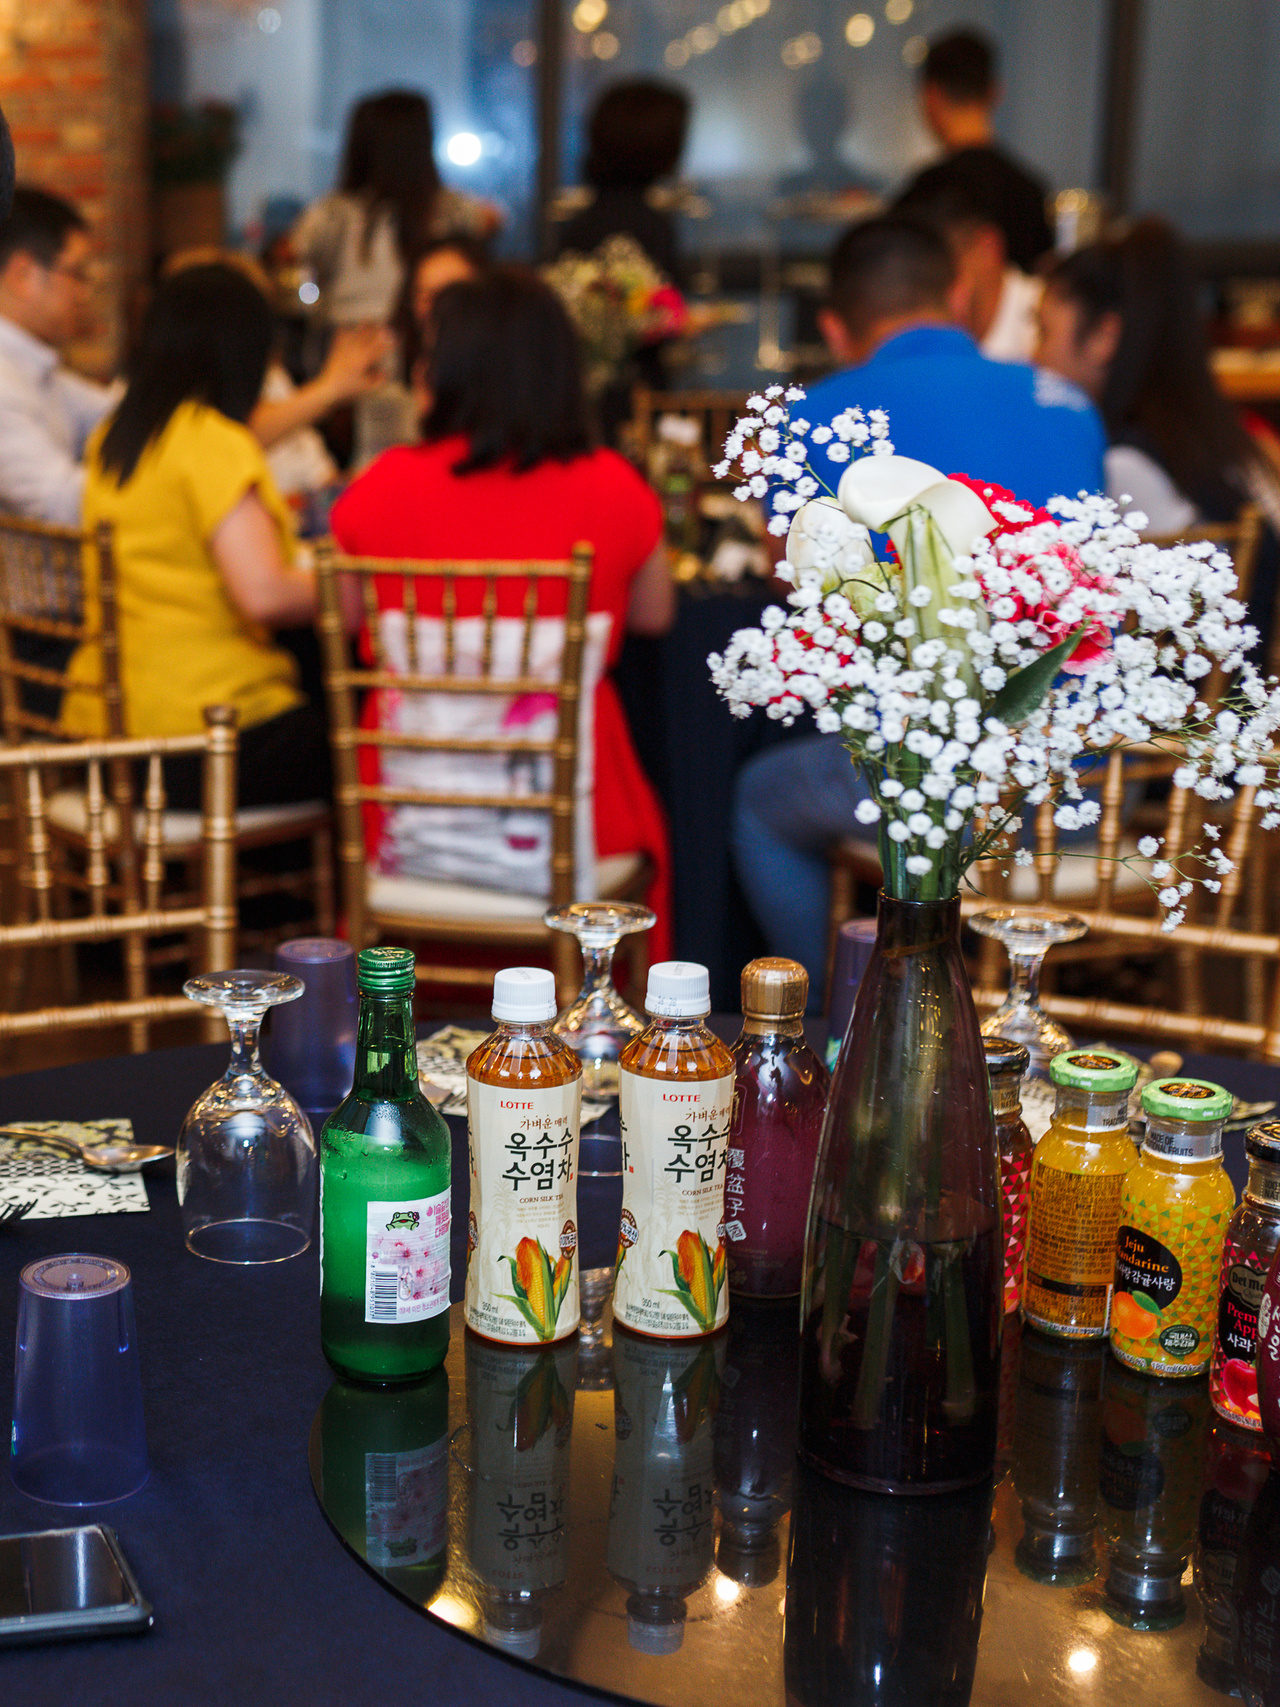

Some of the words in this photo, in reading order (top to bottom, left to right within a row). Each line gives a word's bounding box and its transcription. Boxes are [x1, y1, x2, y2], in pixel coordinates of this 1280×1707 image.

[500, 1100, 534, 1110] LOTTE
[663, 1093, 701, 1103] LOTTE
[685, 1108, 718, 1123] 가벼운
[520, 1116, 553, 1130] 가벼운
[505, 1127, 573, 1161] 옥수수
[1165, 1135, 1175, 1146] OF
[1168, 1147, 1194, 1157] FRUITS
[502, 1154, 572, 1191] 수염차
[726, 1148, 745, 1218] 覆盆子
[702, 1187, 713, 1195] SILK
[519, 1196, 538, 1204] CORN
[539, 1195, 554, 1203] SILK
[1124, 1236, 1144, 1253] Jeju
[1232, 1271, 1247, 1288] Del
